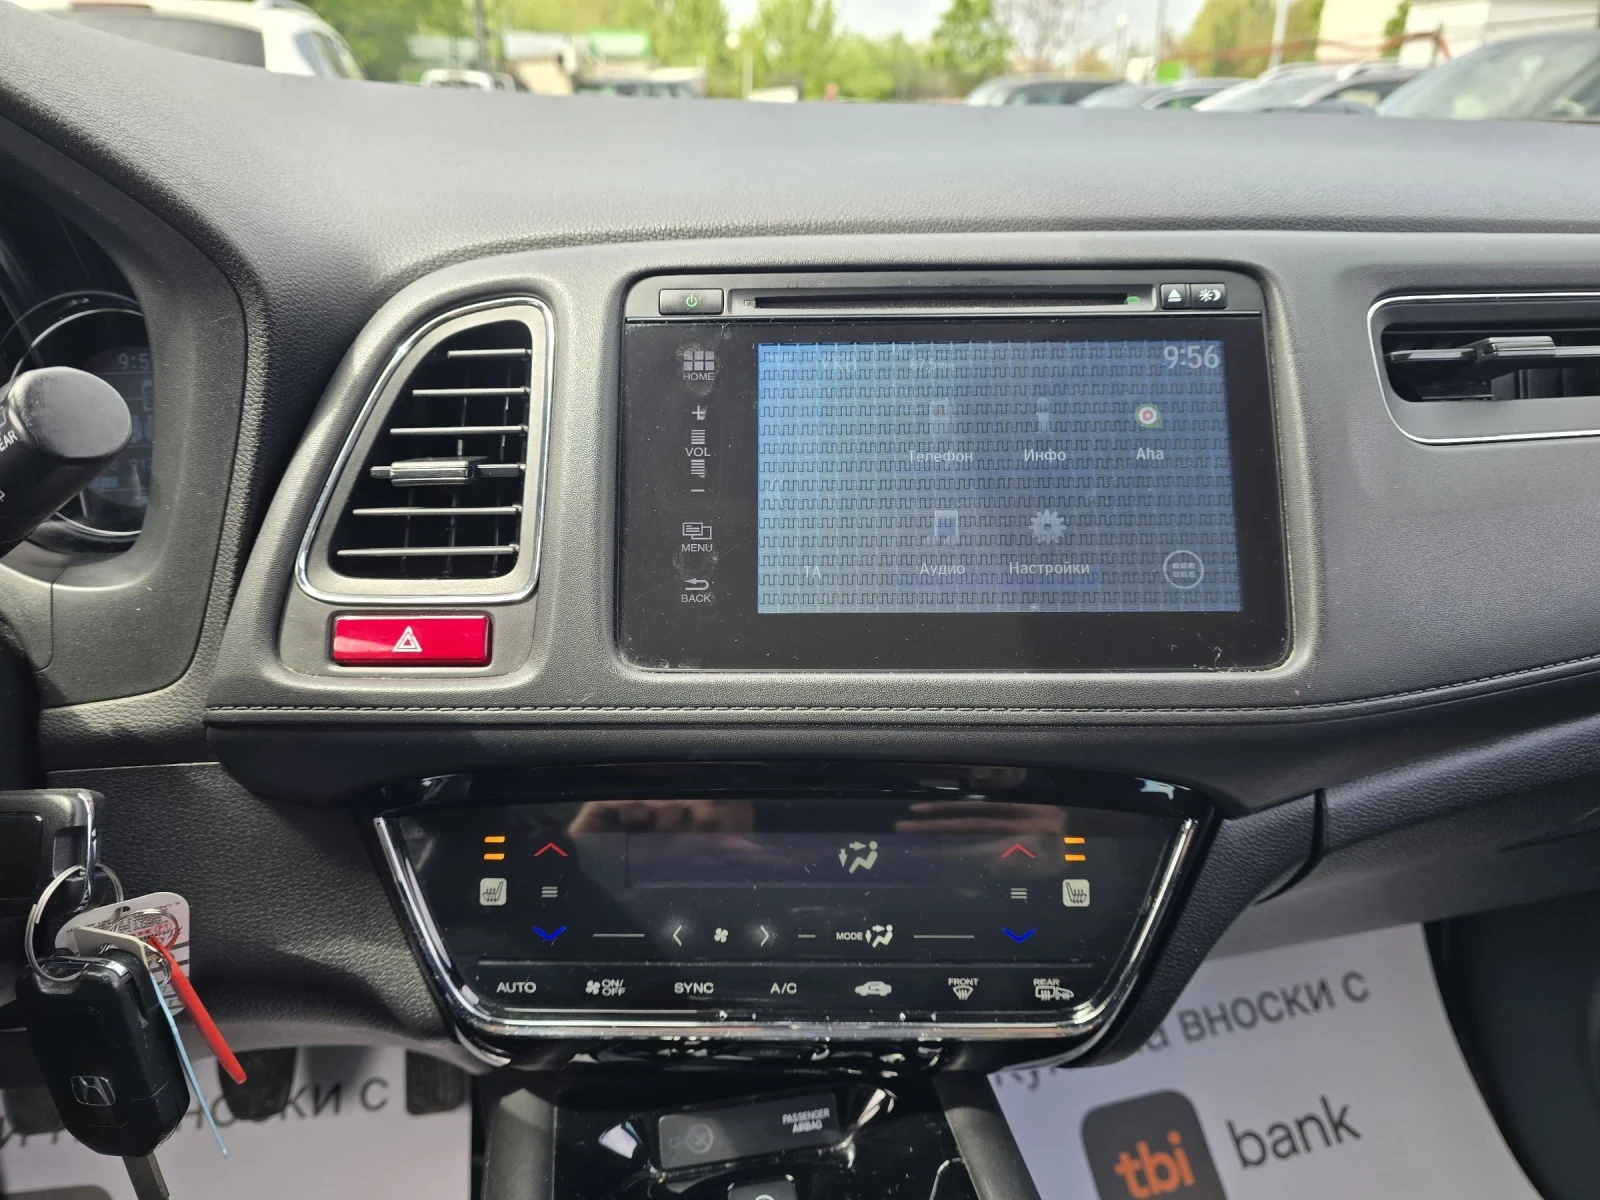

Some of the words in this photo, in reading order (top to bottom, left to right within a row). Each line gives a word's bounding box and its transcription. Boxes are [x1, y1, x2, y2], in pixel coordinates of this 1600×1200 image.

[118, 353, 149, 370] 9:5
[1163, 345, 1220, 369] 9:56
[682, 372, 715, 381] HOME
[0, 429, 18, 452] EAR
[685, 447, 711, 457] VOL
[908, 449, 973, 466] Телефон
[1023, 447, 1067, 464] Инфо
[1136, 447, 1165, 461] Aha
[681, 543, 713, 552] MENU
[919, 562, 966, 577] Аудио
[1009, 560, 1090, 577] Настройки
[681, 594, 711, 603] BACK
[835, 931, 863, 941] MODE
[496, 981, 537, 994] AUTO
[601, 979, 624, 988] ON/
[674, 982, 714, 994] SYNC
[770, 982, 797, 994] A/C
[948, 977, 979, 986] FRONT
[1033, 978, 1060, 986] REAR
[602, 987, 626, 997] OFF
[782, 1107, 830, 1125] PASSENGER
[792, 1119, 823, 1133] AIRBAG
[1114, 1130, 1196, 1200] tbi
[1226, 1095, 1363, 1168] bank
